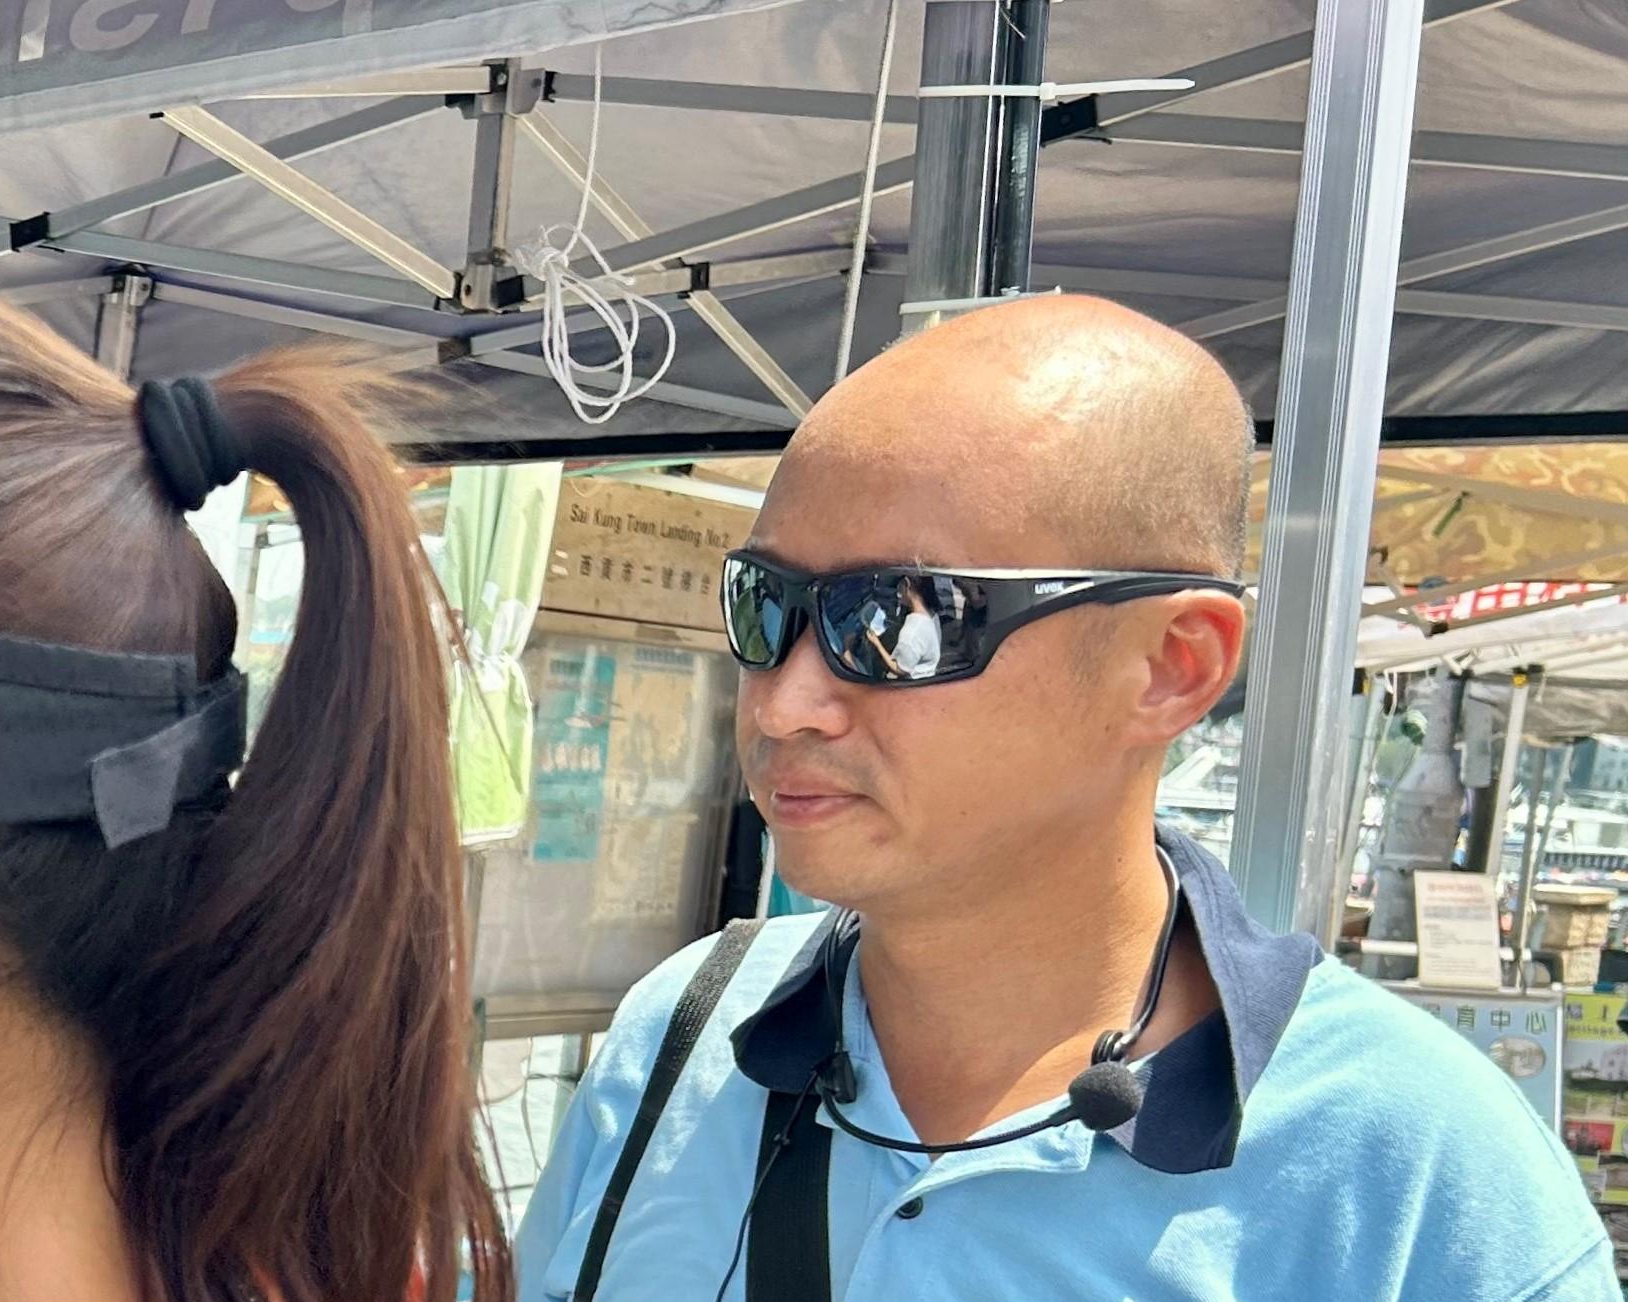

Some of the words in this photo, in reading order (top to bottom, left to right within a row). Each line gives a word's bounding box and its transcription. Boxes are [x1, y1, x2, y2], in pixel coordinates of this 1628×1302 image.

[570, 503, 589, 523] Sai
[593, 507, 622, 534] Kung
[626, 513, 655, 535] Town
[660, 520, 702, 547] Landing
[1034, 581, 1065, 595] uvex
